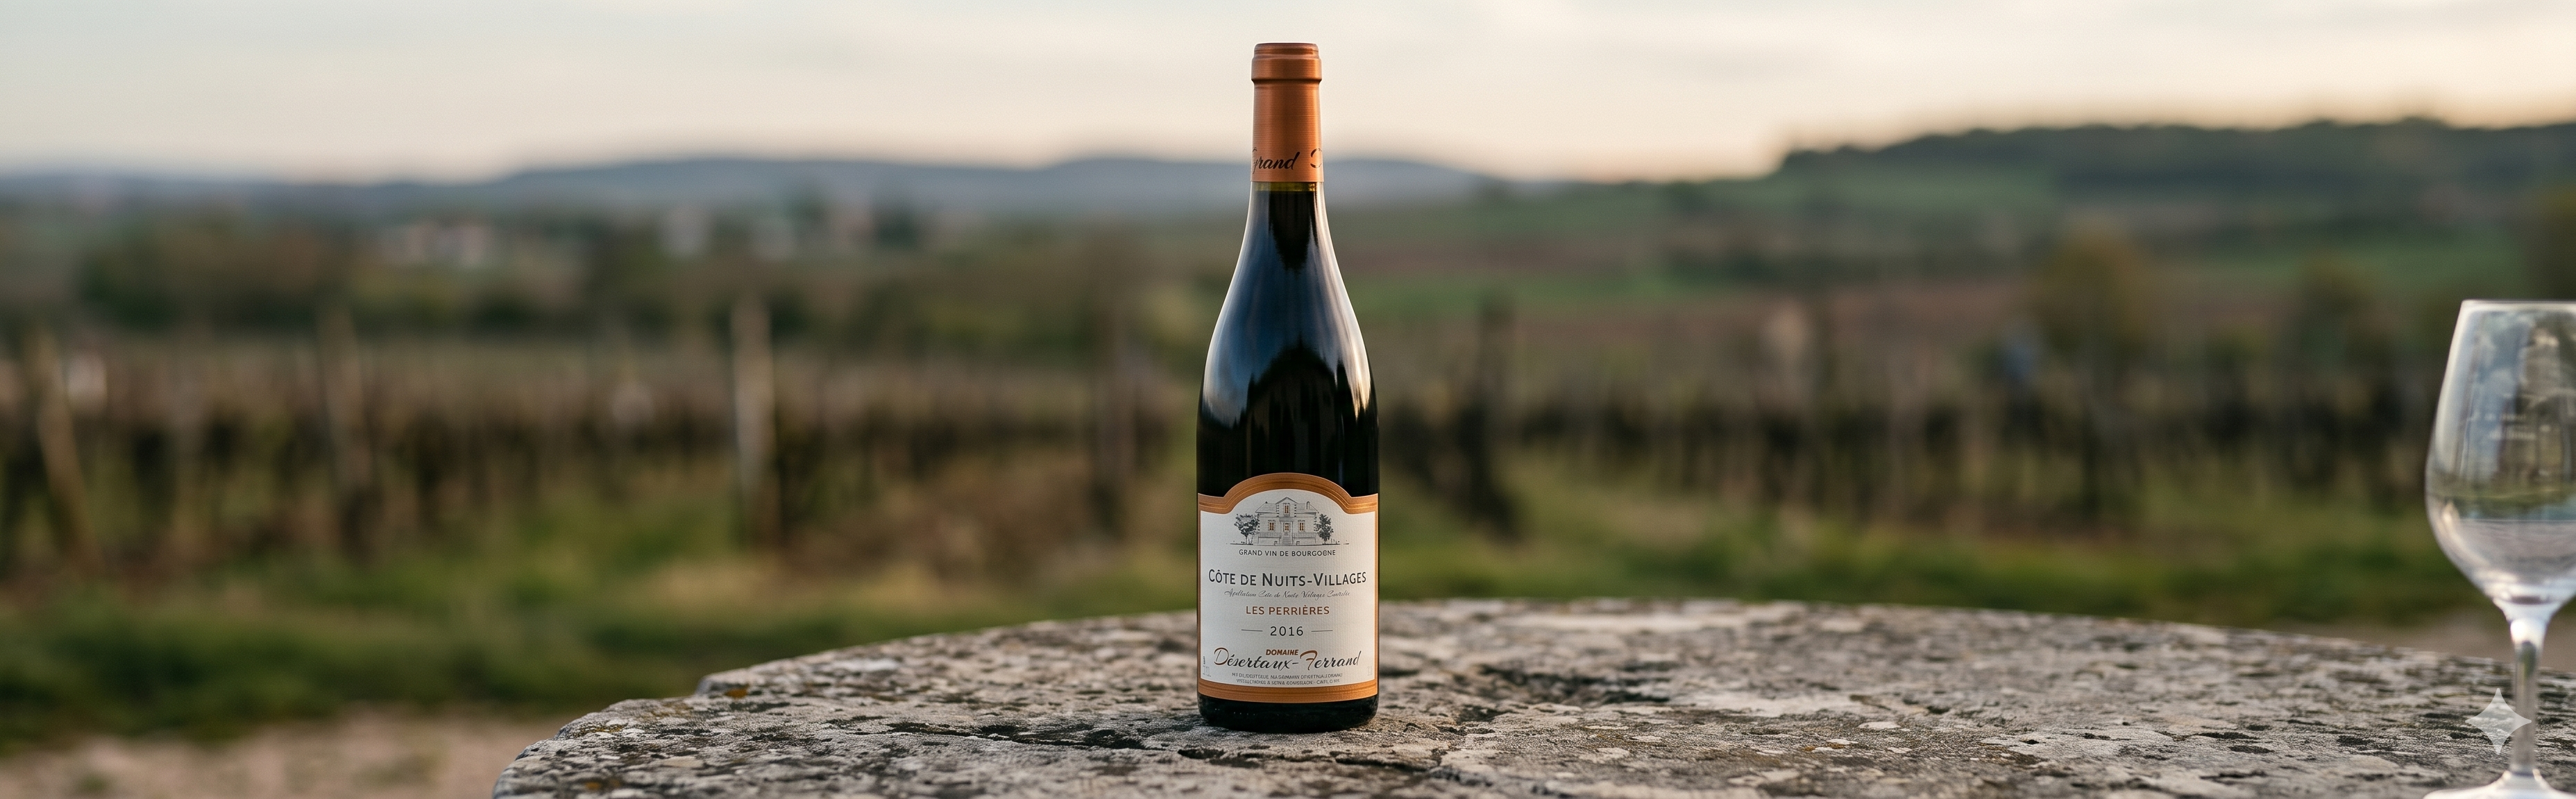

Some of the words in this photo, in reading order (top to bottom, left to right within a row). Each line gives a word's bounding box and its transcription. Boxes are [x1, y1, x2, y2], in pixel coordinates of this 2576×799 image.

[1241, 574, 1257, 586] DE
[1262, 572, 1366, 587] NUITS-VILLAGES
[1246, 606, 1264, 615] LES
[1269, 605, 1330, 615] PERRIÈRES
[1270, 626, 1303, 636] 2016
